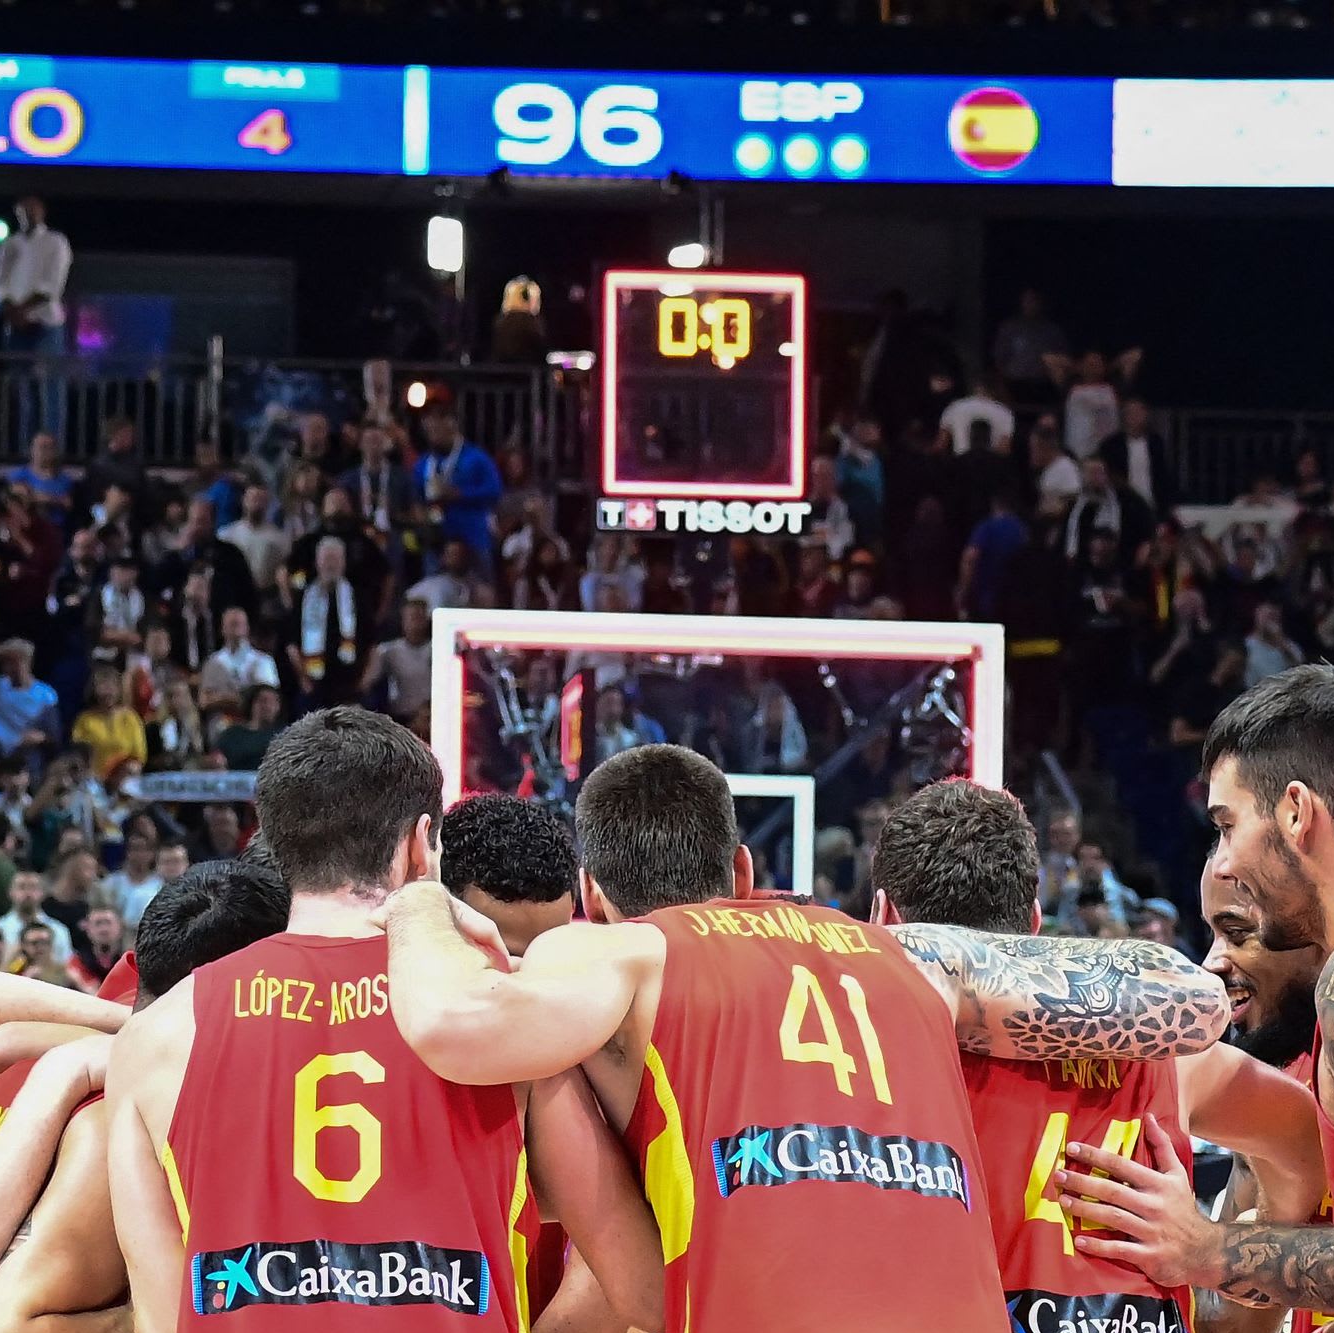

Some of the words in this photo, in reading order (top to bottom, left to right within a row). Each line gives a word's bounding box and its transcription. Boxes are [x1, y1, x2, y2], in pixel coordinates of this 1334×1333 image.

[492, 83, 663, 167] 96
[740, 81, 864, 122] ESP
[237, 108, 293, 155] 4
[656, 500, 812, 534] TISSOT
[778, 964, 894, 1106] 41
[292, 1050, 386, 1203] 6
[256, 1249, 476, 1306] CaixaBank
